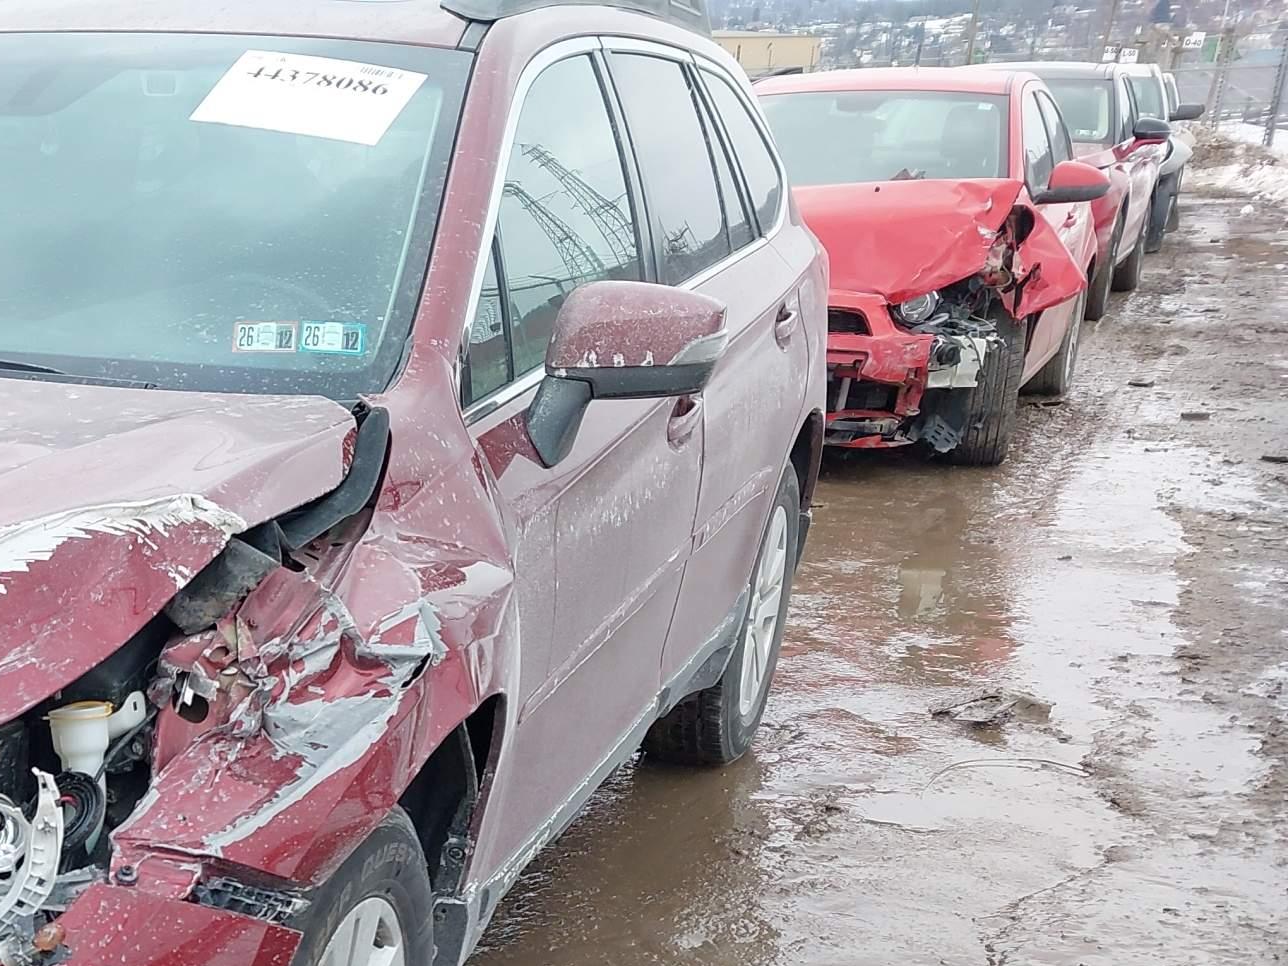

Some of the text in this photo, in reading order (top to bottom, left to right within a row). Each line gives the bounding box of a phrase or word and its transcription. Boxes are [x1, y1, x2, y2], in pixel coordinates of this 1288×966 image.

[247, 66, 388, 95] 44378086
[239, 326, 255, 347] 26
[277, 330, 293, 349] 12
[304, 325, 320, 347] 26
[343, 331, 360, 351] 12
